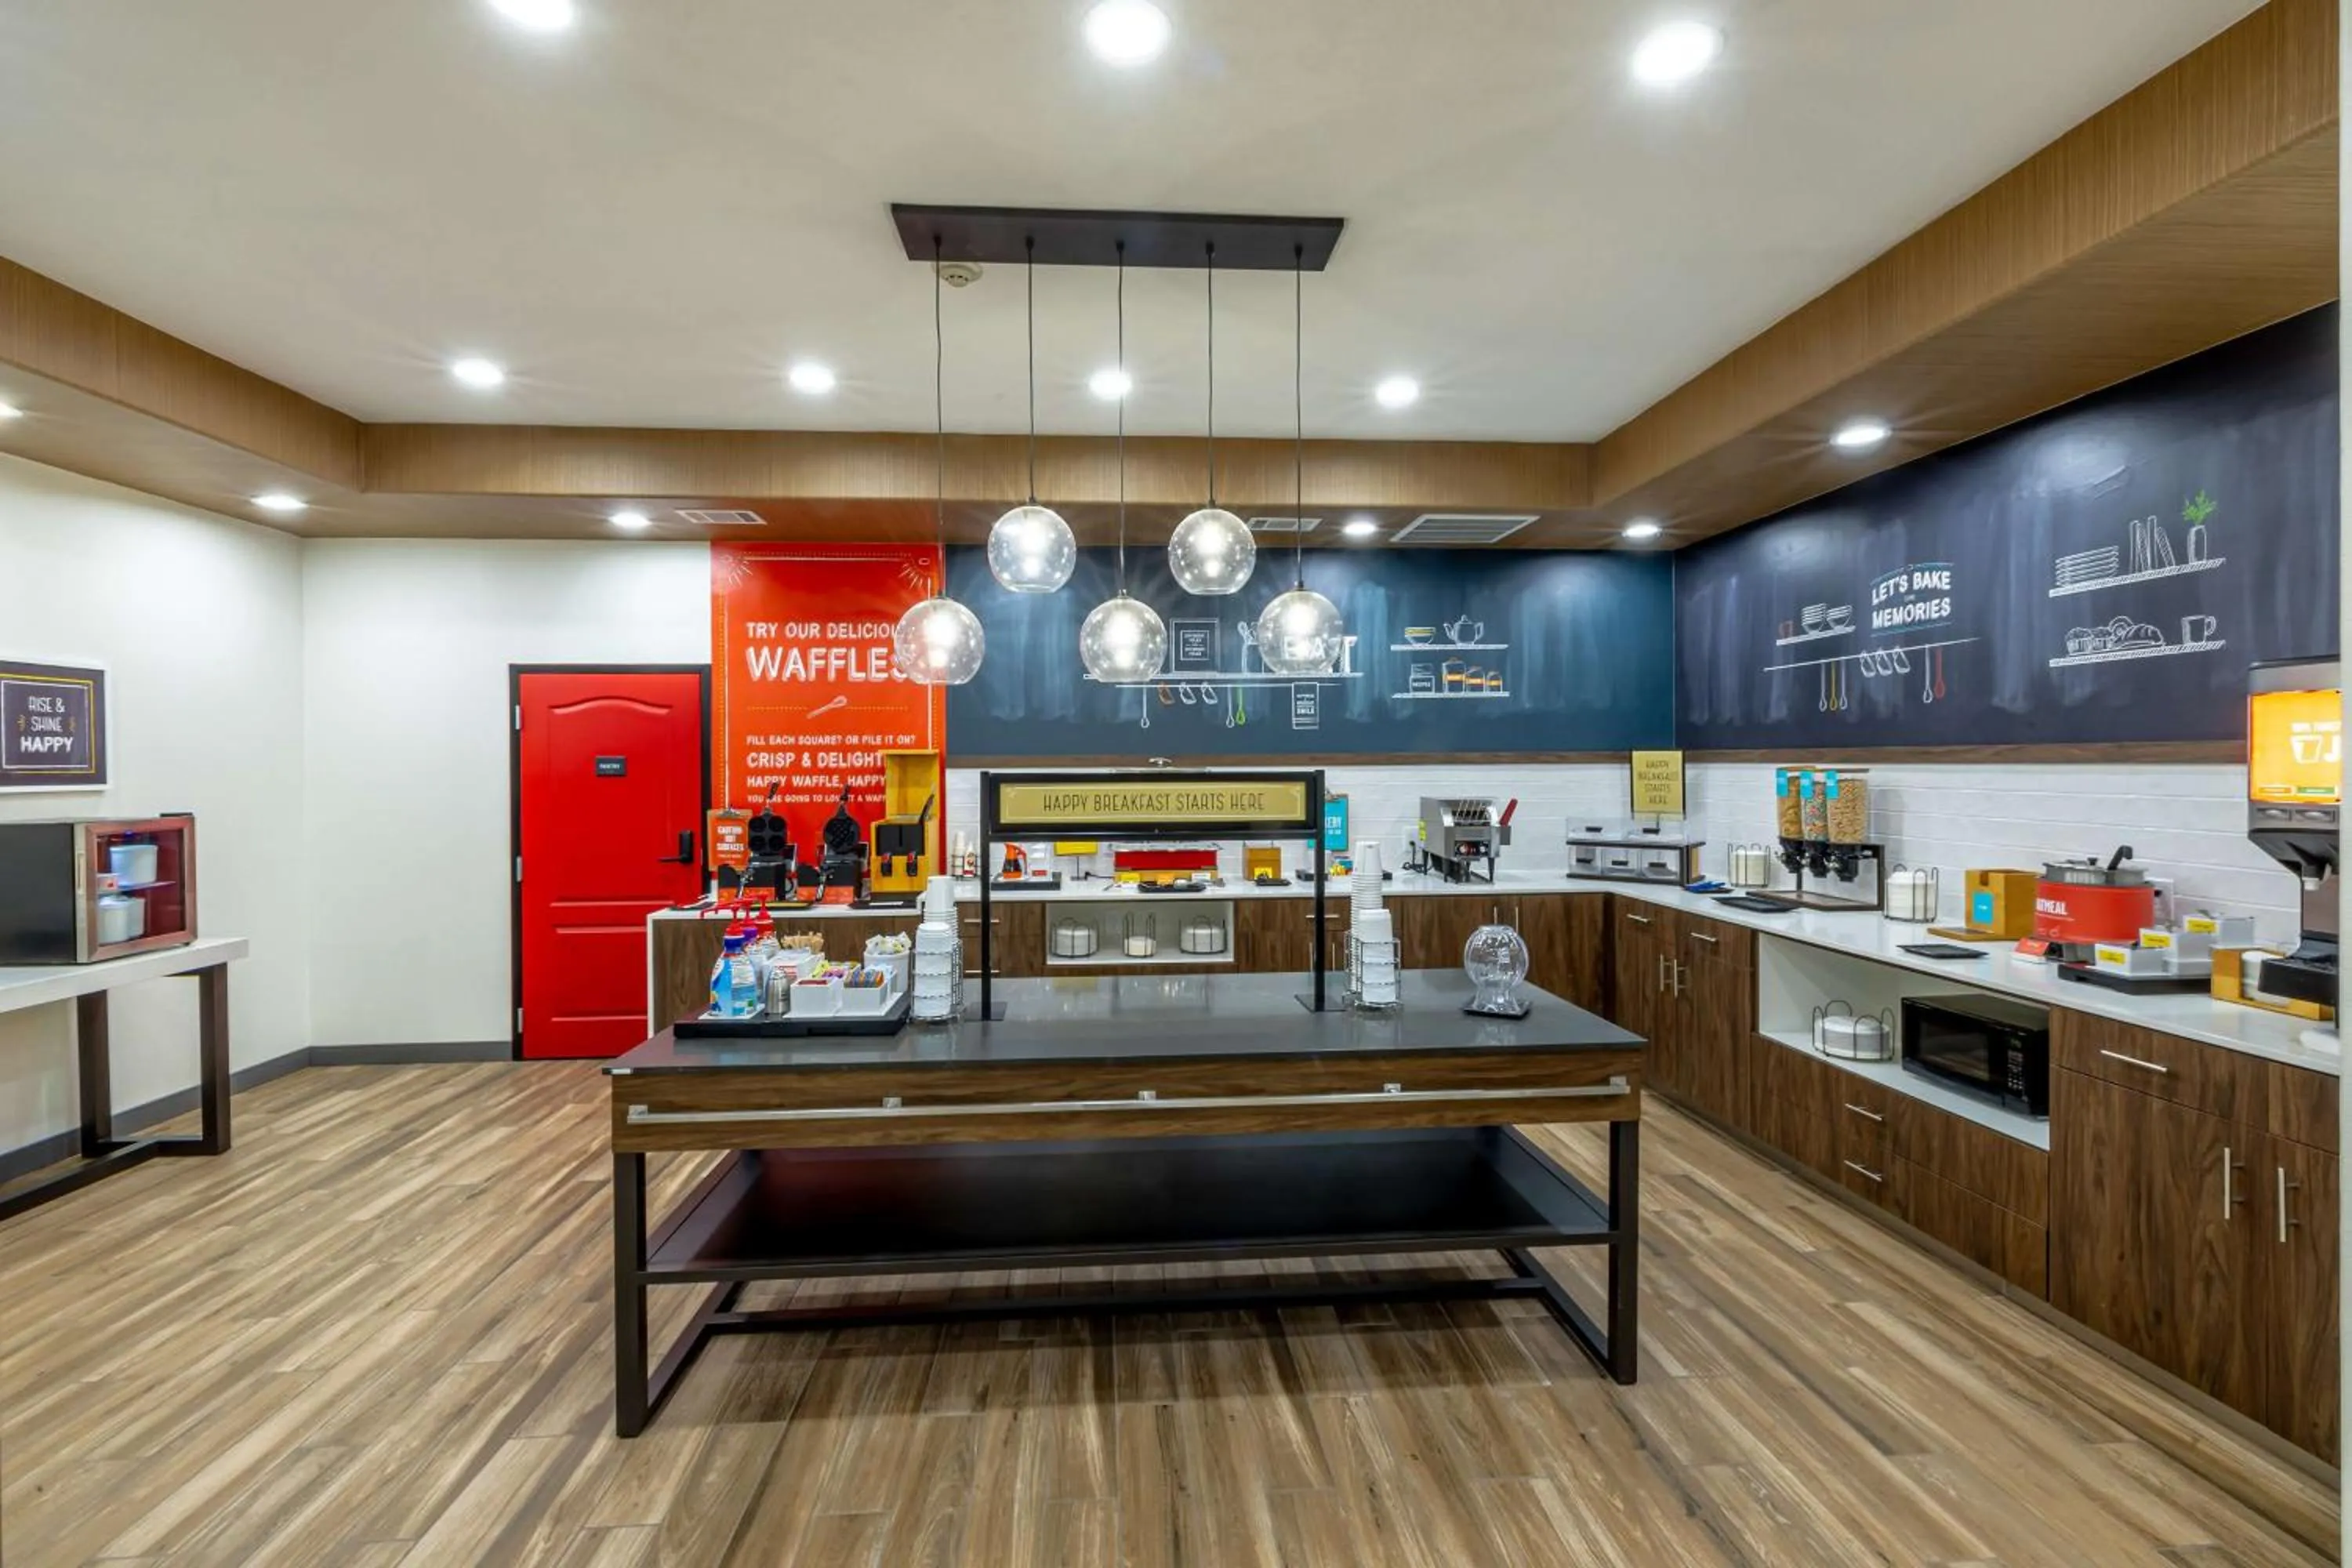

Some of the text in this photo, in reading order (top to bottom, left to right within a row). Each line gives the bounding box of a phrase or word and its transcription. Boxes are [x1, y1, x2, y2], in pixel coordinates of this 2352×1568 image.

[1871, 570, 1951, 606] LET'S BAKE
[1871, 597, 1951, 630] MEMORIES
[747, 622, 778, 639] TRY
[785, 622, 821, 639] OUR
[28, 696, 66, 713] RISE &
[31, 716, 63, 732] SHINE
[20, 735, 74, 753] HAPPY
[746, 735, 766, 746] FILL
[769, 735, 795, 746] EACH
[798, 735, 842, 746] SQUARE?
[845, 735, 859, 746] OR
[862, 735, 882, 746] PILE
[885, 735, 894, 746] IT
[746, 751, 796, 768] CRISP
[802, 752, 811, 768] &
[746, 775, 787, 787] HAPPY
[848, 775, 886, 787] HAPPY
[1043, 792, 1265, 811] HAPPY BREAKFAST STARTS HERE
